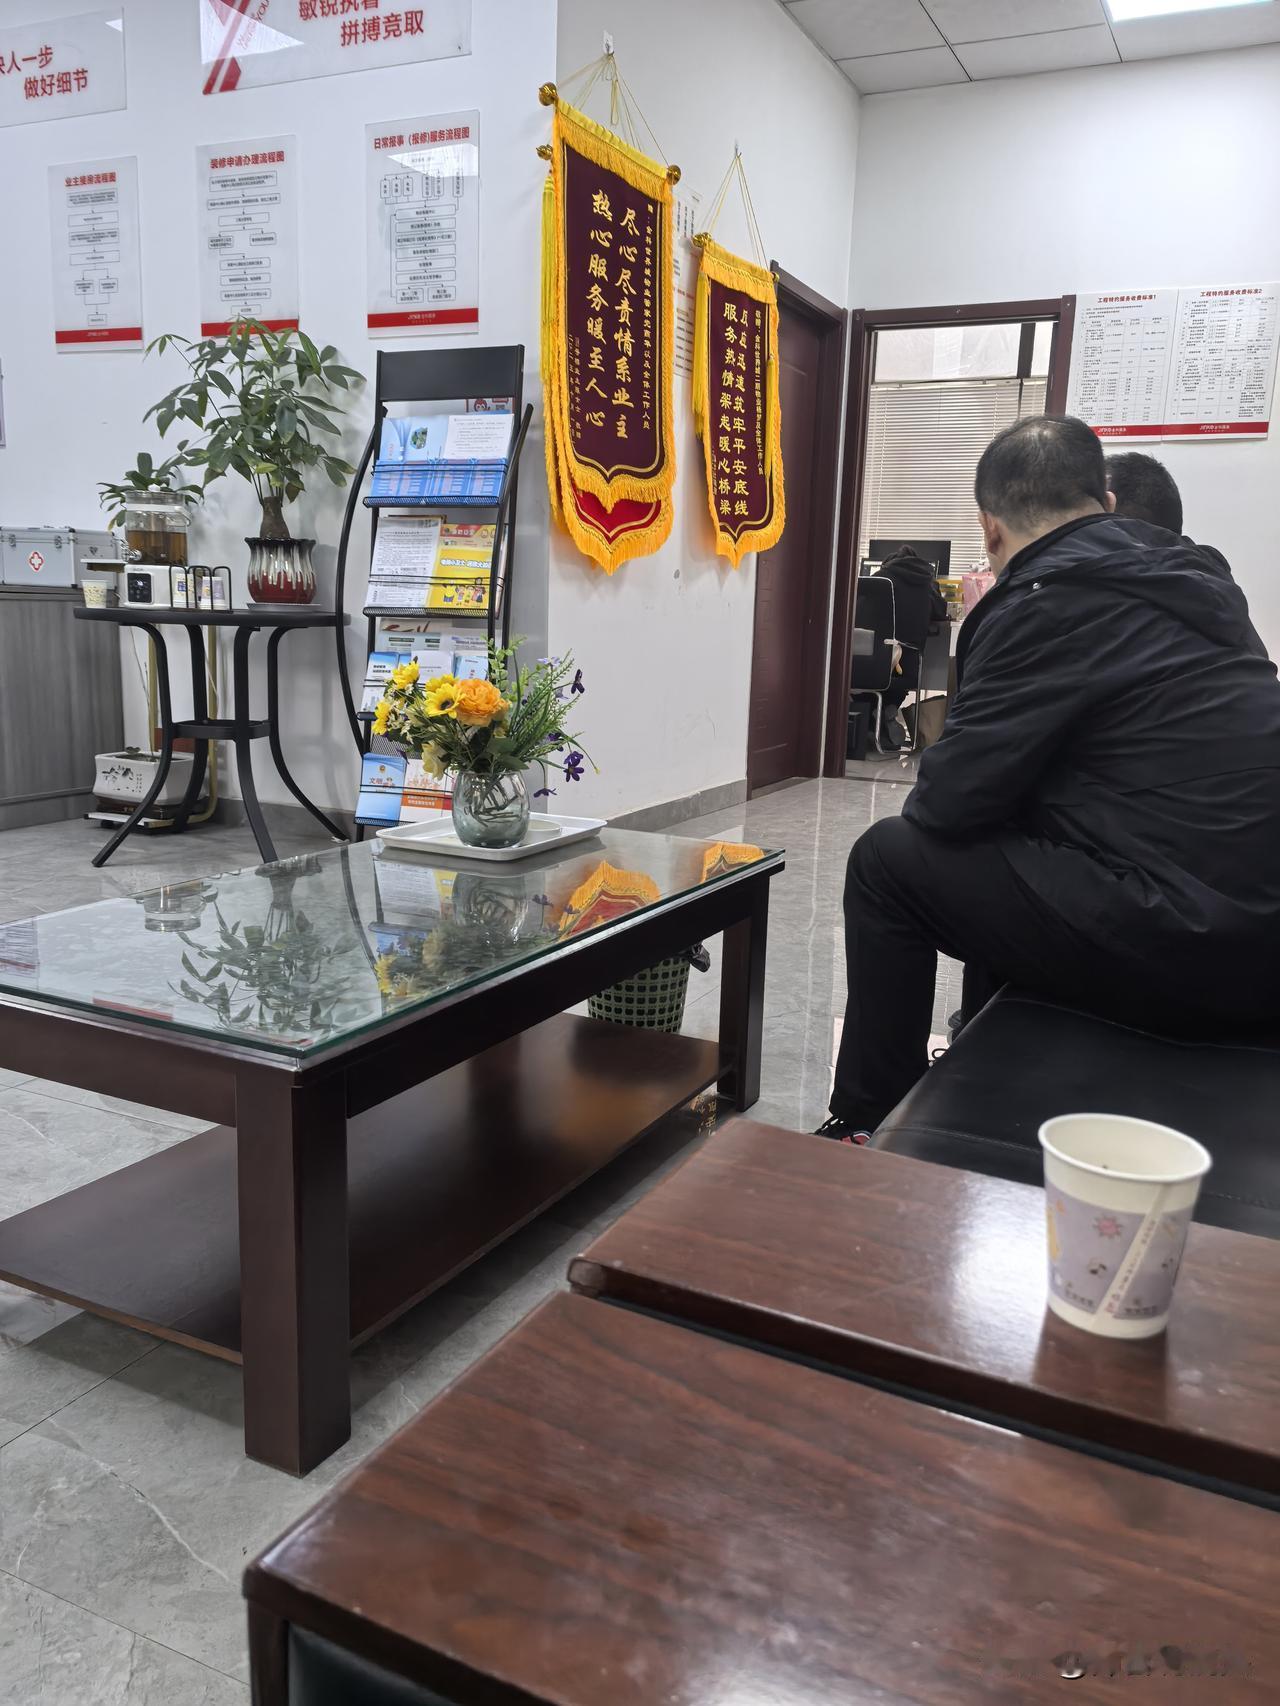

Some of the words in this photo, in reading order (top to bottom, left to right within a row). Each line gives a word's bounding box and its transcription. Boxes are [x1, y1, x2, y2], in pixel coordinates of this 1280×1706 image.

[24, 67, 88, 100] 做好细节
[340, 9, 424, 47] 拼搏竞取
[210, 150, 285, 169] 装修申请办理流程图
[611, 207, 640, 439] 尽心尽责情系业主
[718, 302, 738, 516] 服务热情架起暖心桥梁
[733, 309, 750, 516] 反应迅速筑牢平安底线
